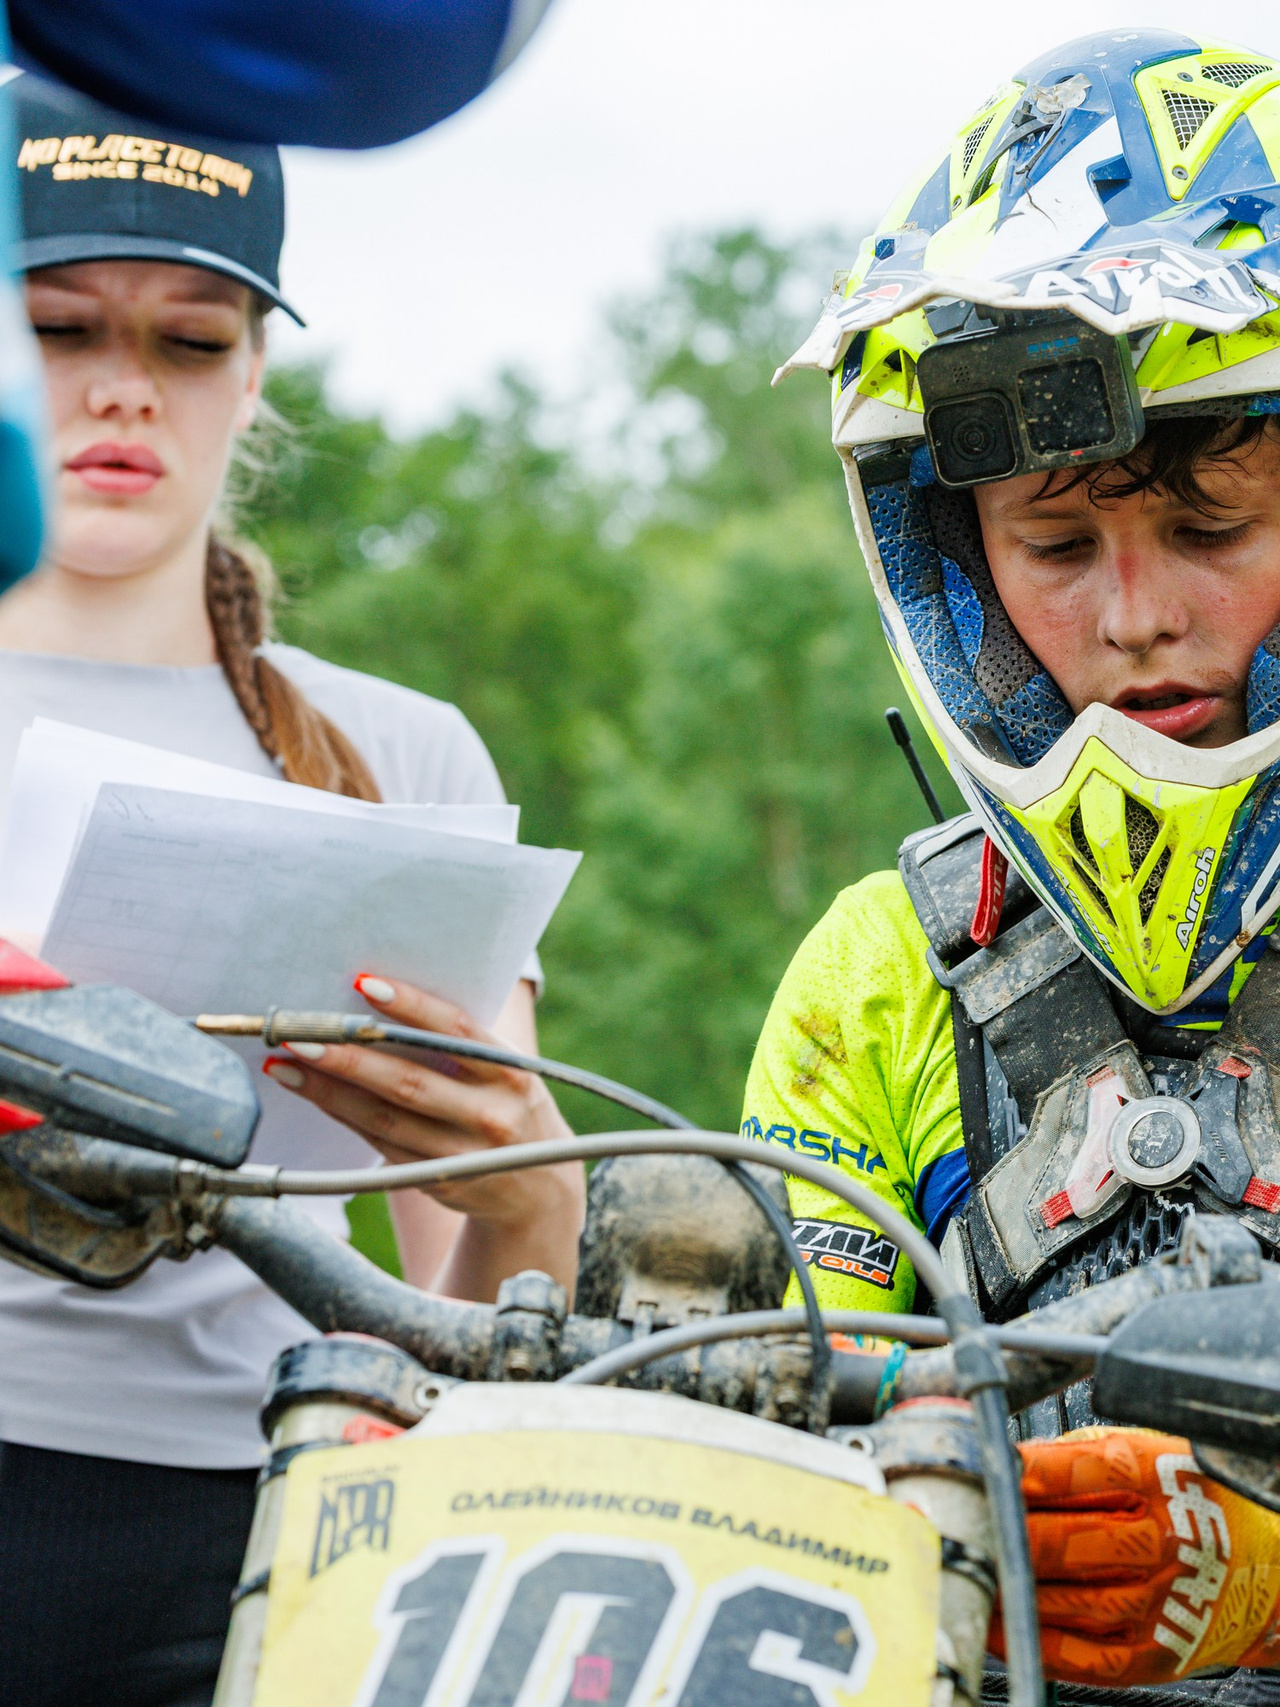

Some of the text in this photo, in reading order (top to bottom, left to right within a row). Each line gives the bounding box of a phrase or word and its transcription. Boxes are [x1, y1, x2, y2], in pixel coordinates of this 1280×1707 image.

[17, 138, 62, 172] NO
[58, 134, 166, 164] PLACE
[165, 143, 204, 173] TO
[52, 161, 139, 180] SINCE
[1176, 846, 1216, 952] Airoh
[819, 1254, 890, 1285] OILS
[450, 1485, 891, 1576] ОЛЕЙНИКОВ ВЛАДИМИР
